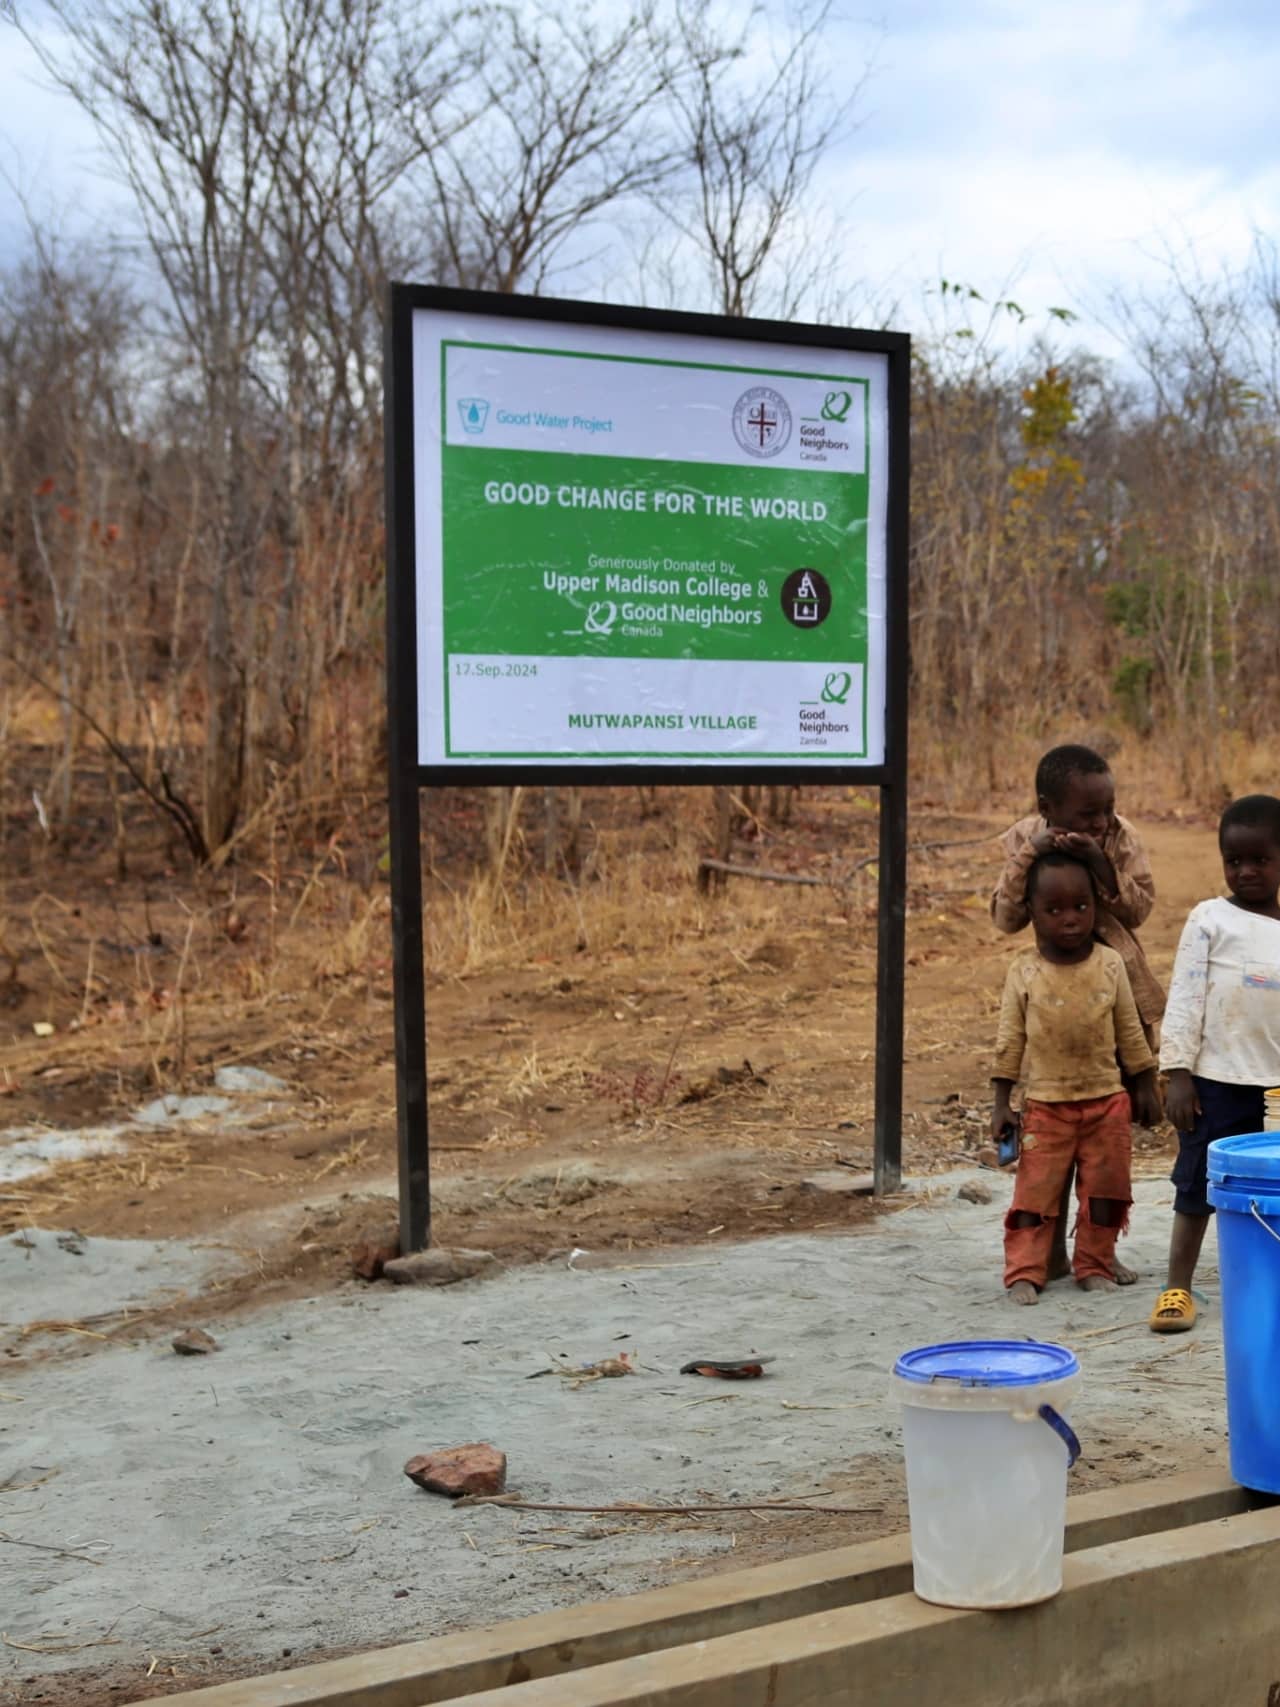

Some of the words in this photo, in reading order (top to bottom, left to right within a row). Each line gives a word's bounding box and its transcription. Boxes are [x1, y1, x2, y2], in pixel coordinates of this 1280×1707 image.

[496, 410, 531, 425] Good
[533, 412, 569, 428] Water
[573, 415, 613, 433] Project
[800, 425, 825, 436] Good
[800, 438, 849, 450] Neighbors
[800, 452, 827, 461] Canada
[484, 481, 550, 507] GOOD
[557, 486, 646, 512] CHANGE
[654, 492, 696, 514] FOR
[703, 495, 743, 517] THE
[750, 498, 827, 522] WORLD
[588, 554, 659, 573] Generously
[664, 558, 715, 573] Donated
[720, 561, 736, 575] by
[544, 571, 599, 595] Upper
[605, 574, 680, 596] Madison
[686, 577, 752, 601] College
[758, 580, 769, 598] &
[621, 602, 667, 622] Good
[671, 604, 762, 628] Neighbors
[621, 626, 663, 637] Canada
[455, 663, 538, 680] 17.Sep.2024
[568, 714, 684, 729] MUTWAPANSI
[689, 715, 757, 730] VILLAGE
[800, 709, 826, 720] Good
[800, 721, 849, 735] Neighbors
